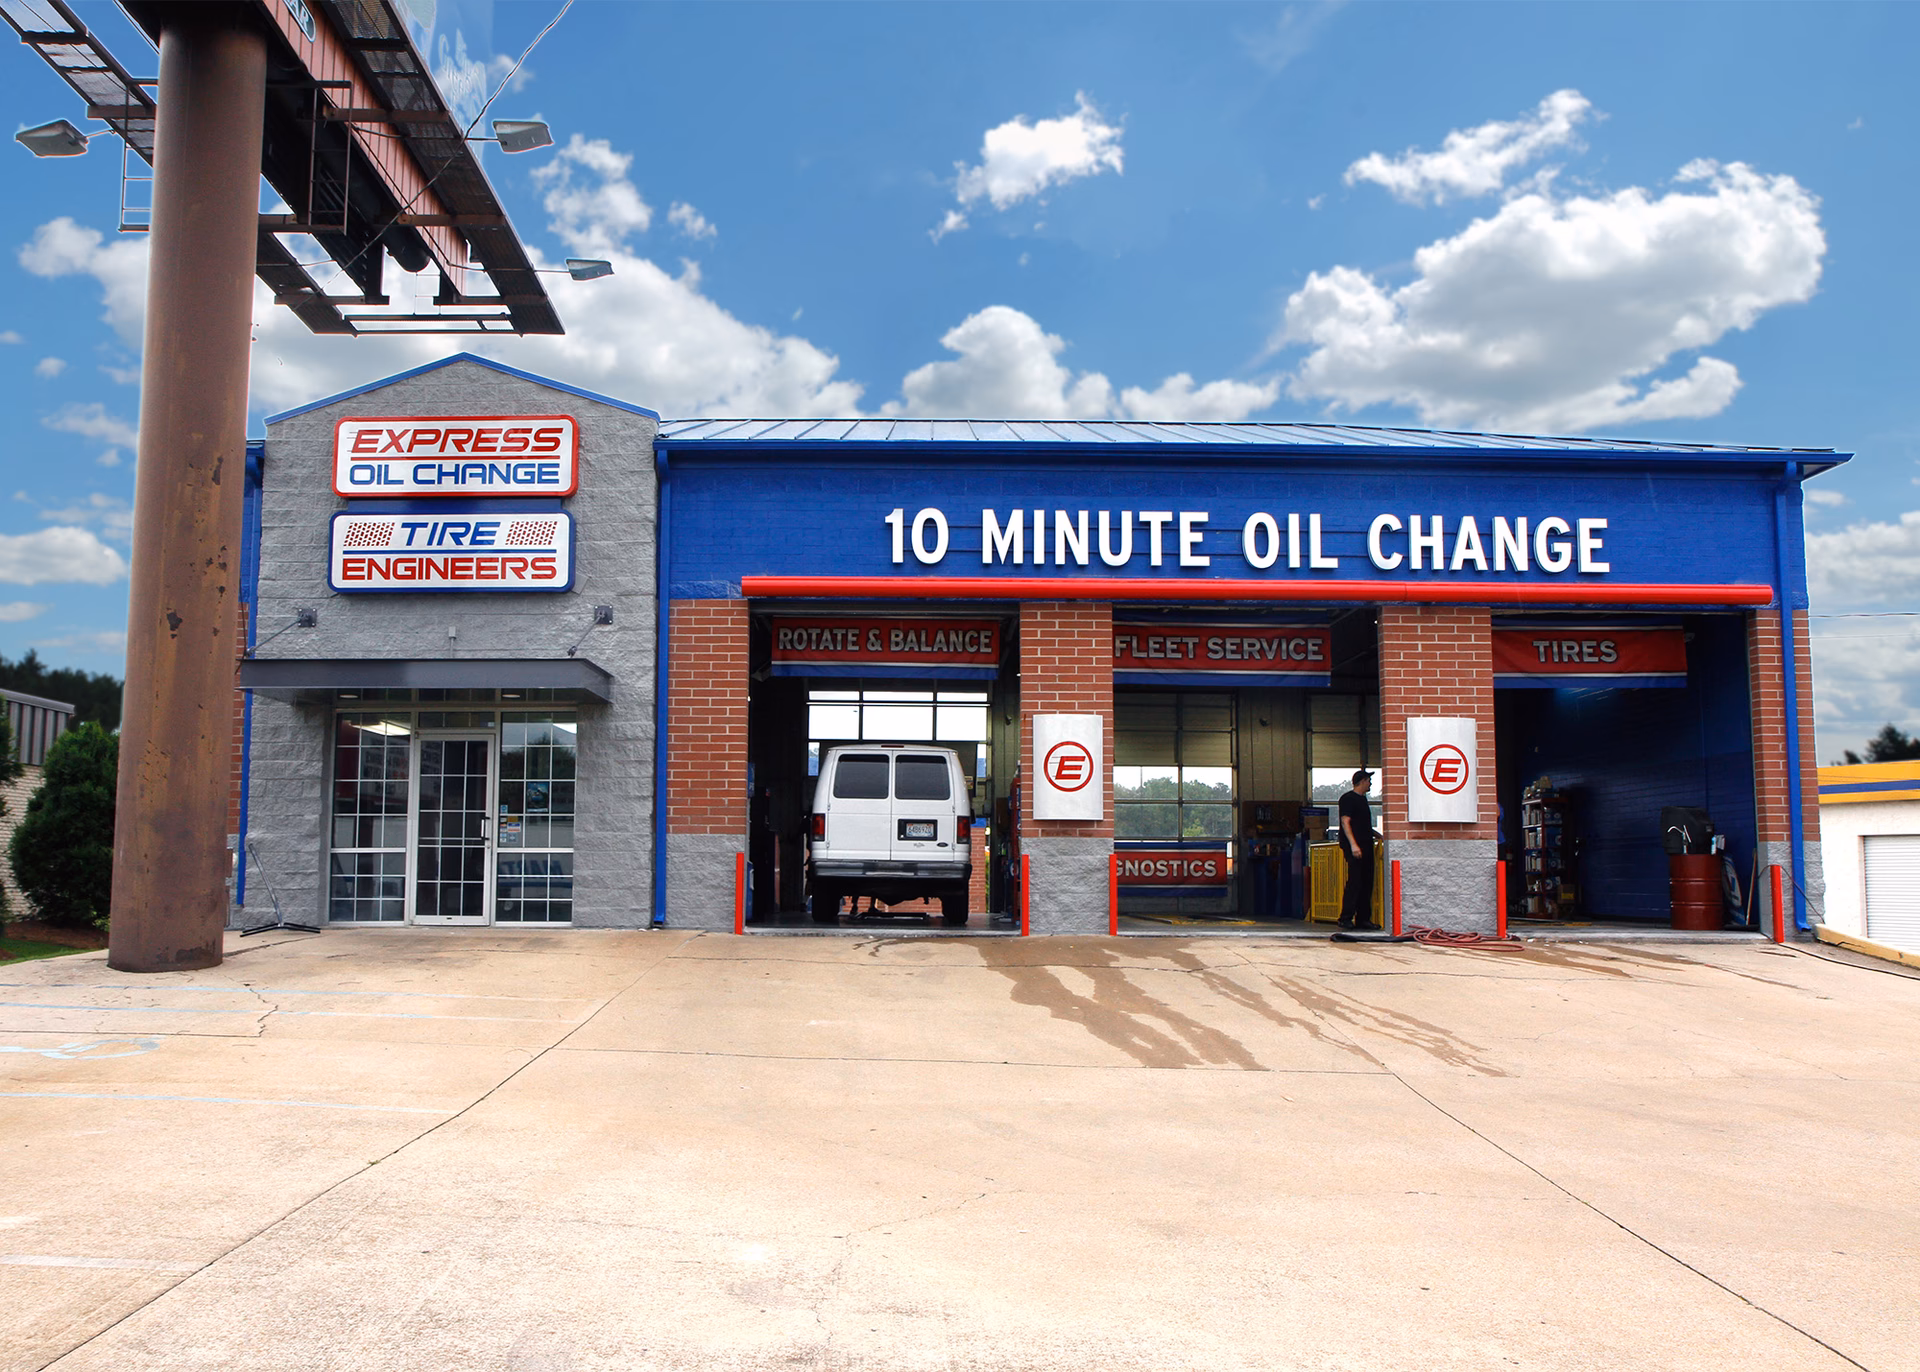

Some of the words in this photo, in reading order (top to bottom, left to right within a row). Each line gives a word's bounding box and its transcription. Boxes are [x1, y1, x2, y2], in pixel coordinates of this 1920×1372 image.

[350, 428, 564, 453] EXPRESS
[349, 464, 404, 485] OIL
[413, 463, 560, 485] CHANGE
[401, 522, 501, 546] TIRE
[885, 508, 949, 565] 10
[982, 509, 1210, 567] MINUTE
[1241, 511, 1339, 569] OIL
[1367, 513, 1611, 573] CHANGE
[342, 557, 557, 580] ENGINEERS
[778, 628, 859, 650] ROTATE
[866, 629, 883, 651] &
[890, 629, 992, 652] BALANCE
[1115, 635, 1199, 659] FLEET
[1207, 637, 1324, 660] SERVICE
[1532, 640, 1618, 662] TIRES
[1055, 756, 1086, 780] E
[1431, 759, 1462, 783] E
